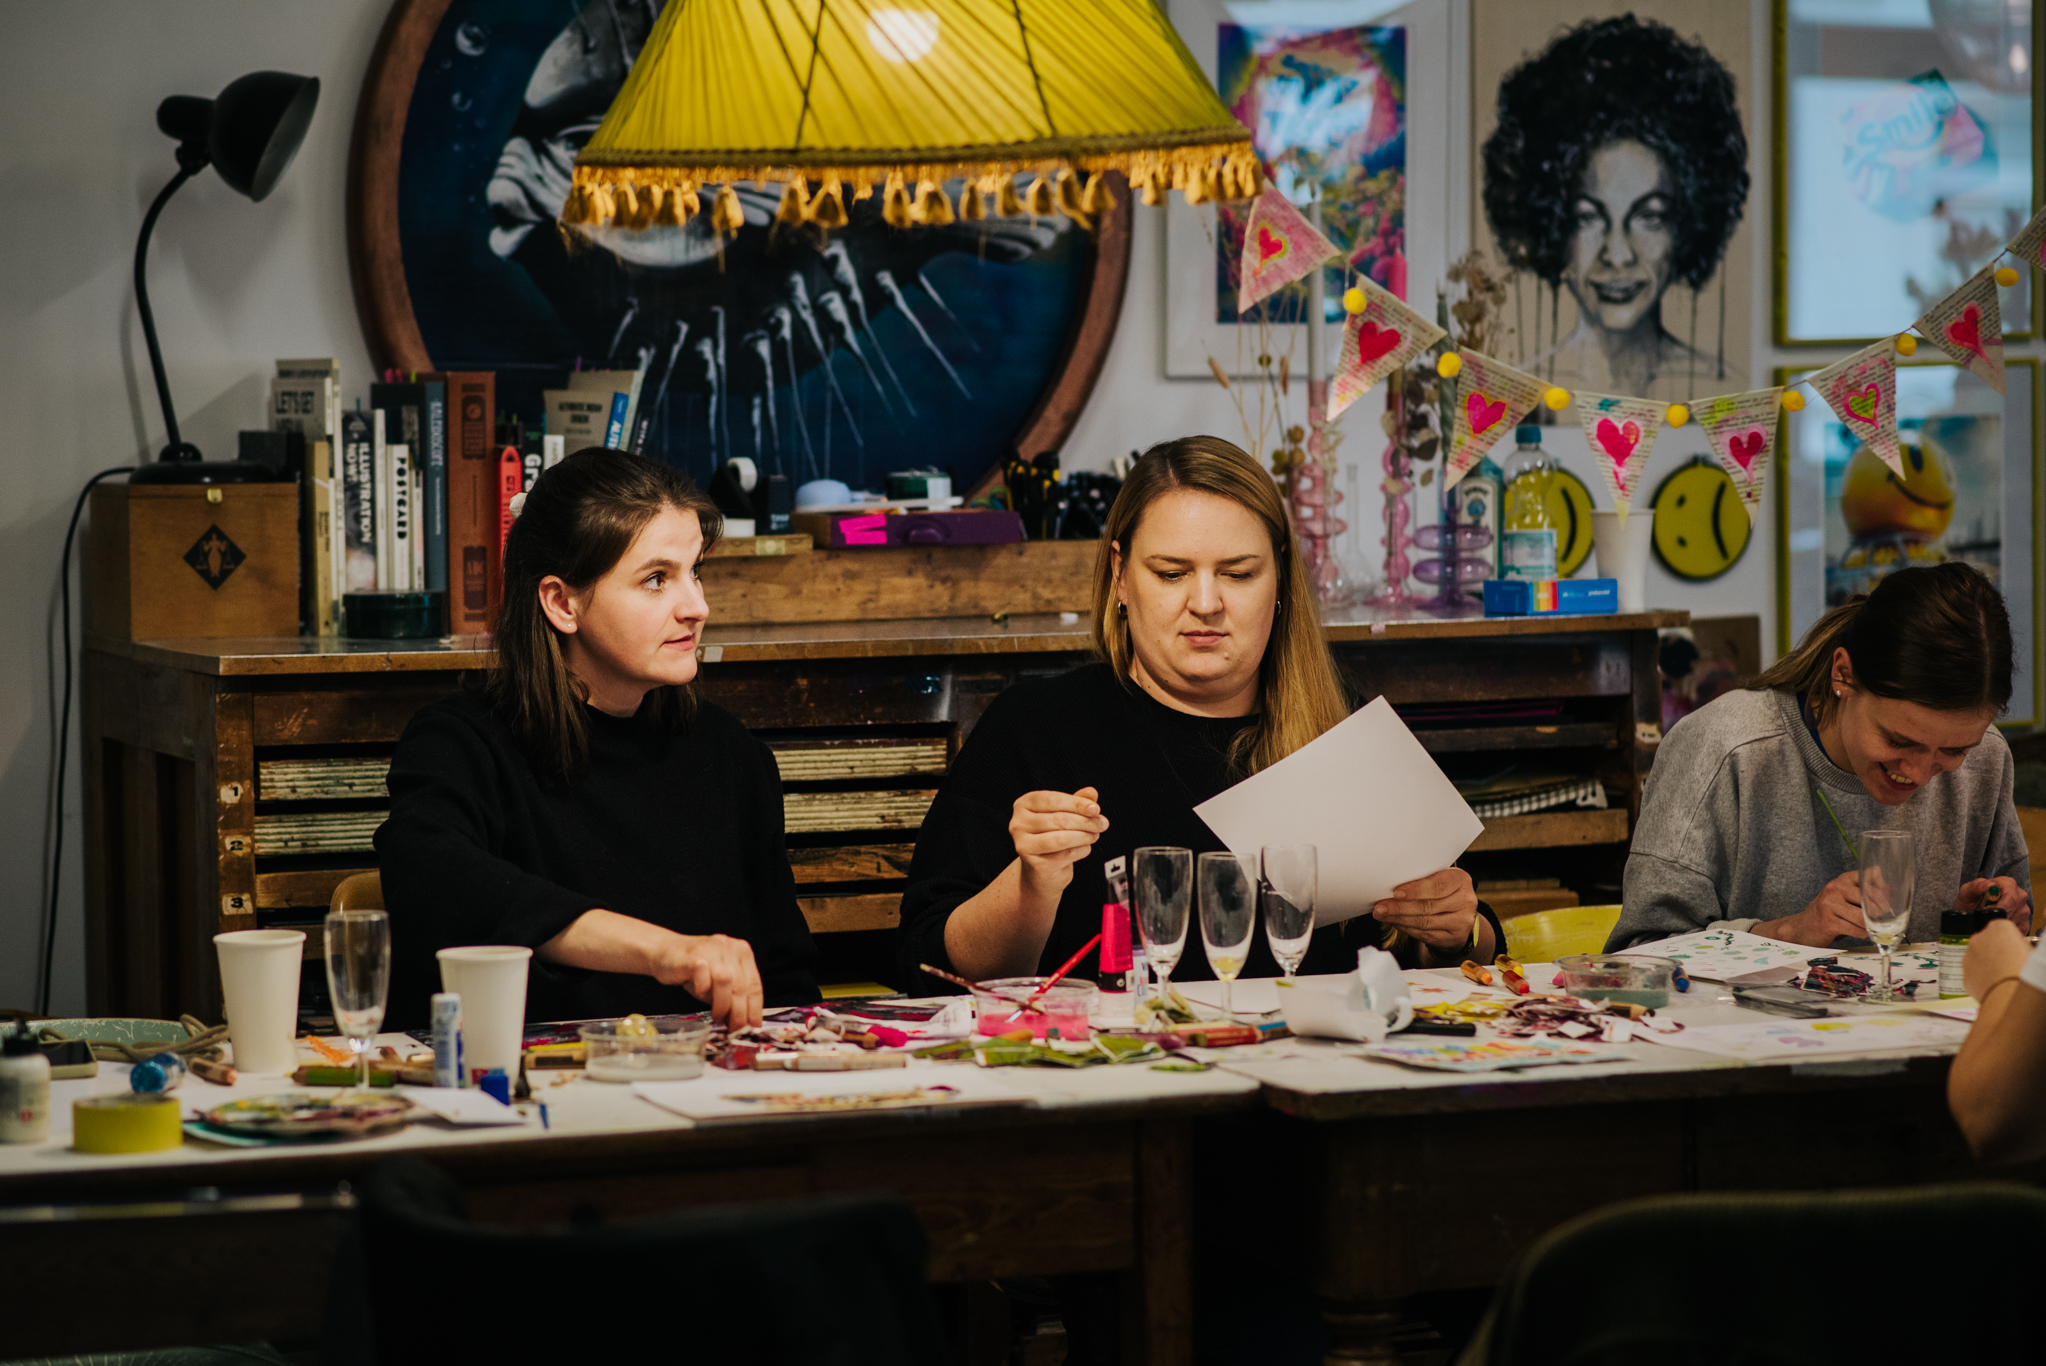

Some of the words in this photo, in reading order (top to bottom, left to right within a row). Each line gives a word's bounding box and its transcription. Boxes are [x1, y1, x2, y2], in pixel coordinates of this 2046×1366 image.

[359, 442, 371, 543] ILLUSTRATION
[396, 457, 407, 540] POSTCARD
[232, 786, 239, 797] 1
[230, 840, 243, 851] 2
[230, 897, 244, 908] 3
